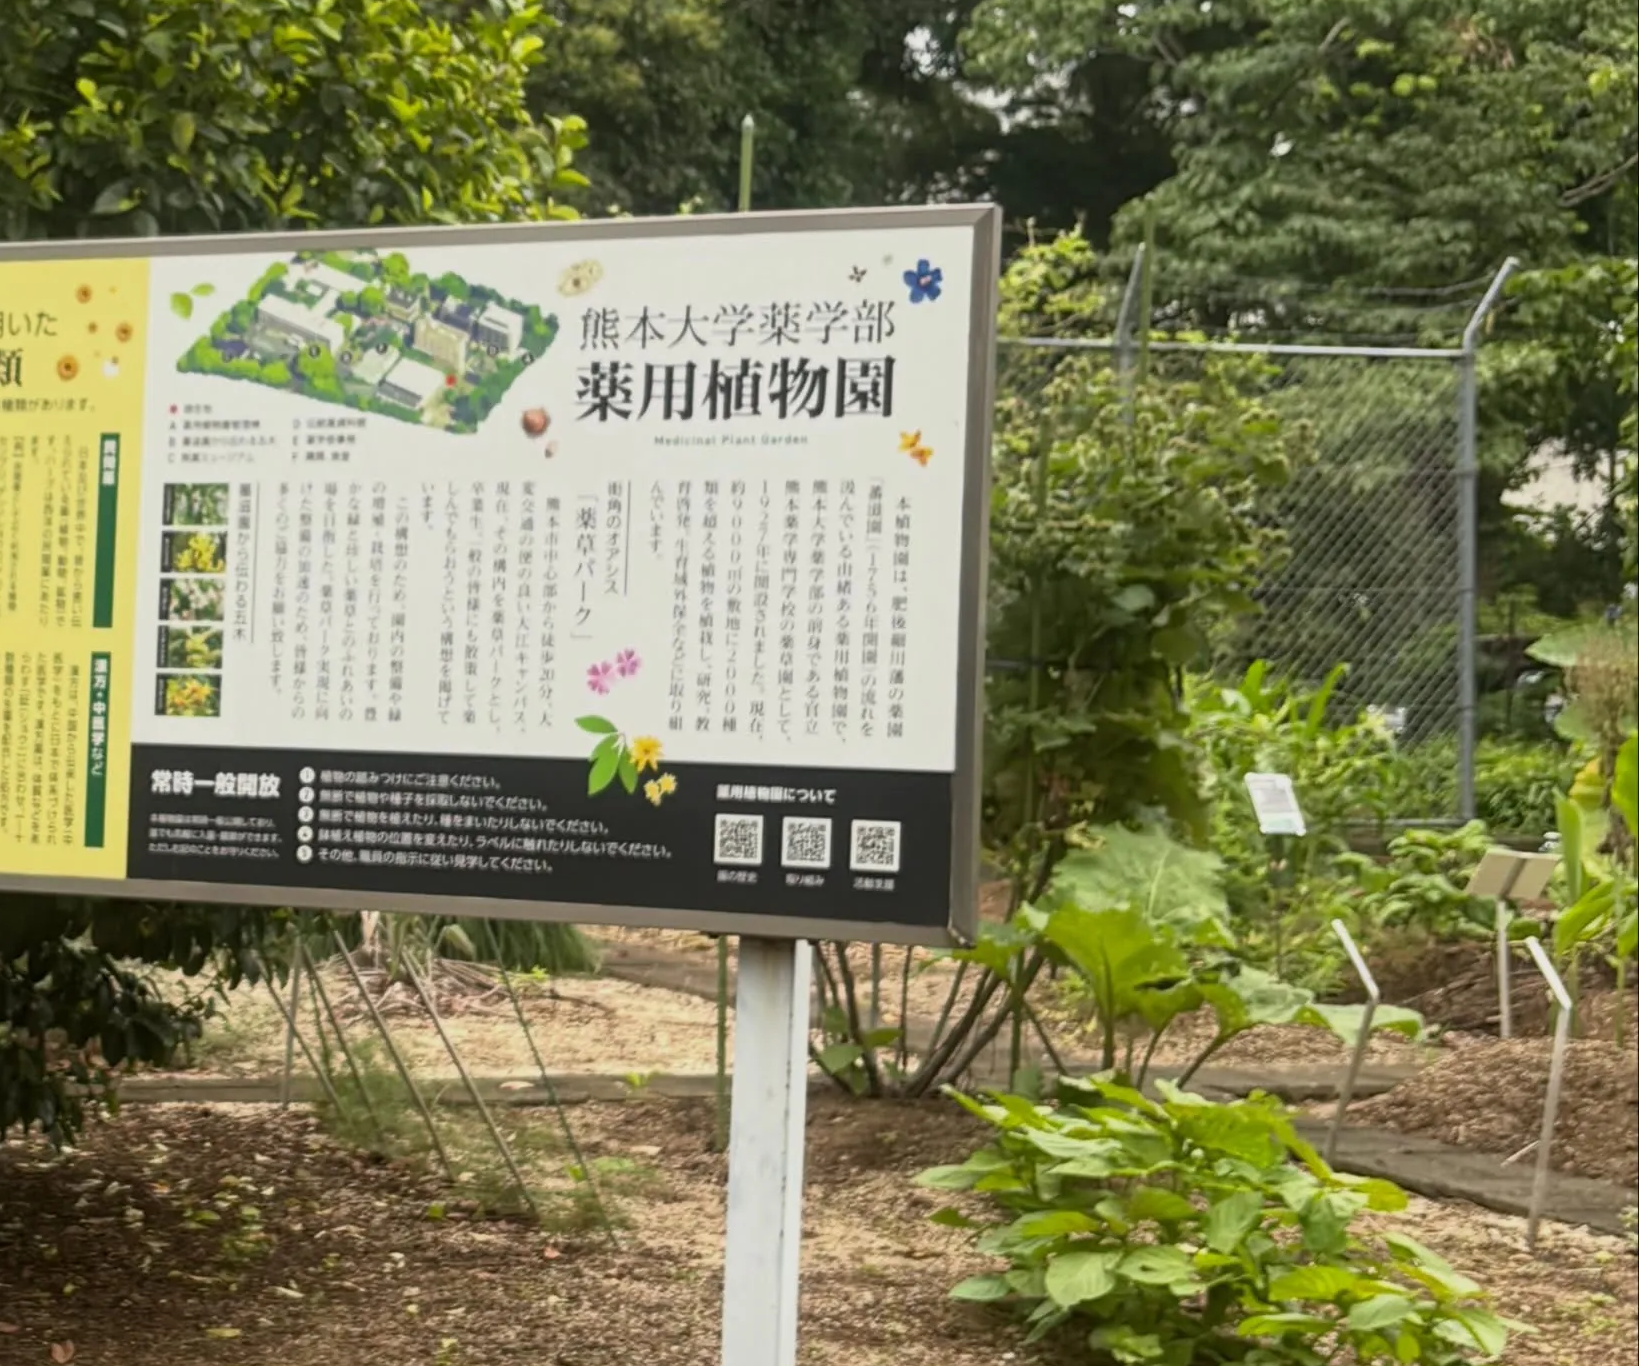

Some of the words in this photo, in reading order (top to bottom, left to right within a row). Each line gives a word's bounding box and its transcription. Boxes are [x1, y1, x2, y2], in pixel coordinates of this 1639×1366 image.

[580, 300, 896, 350] 熊本大学薬学部
[575, 355, 896, 422] 薬用植物園
[654, 434, 714, 447] Medicinal
[722, 434, 755, 446] Plant
[761, 434, 808, 446] Garden
[422, 484, 435, 531] います。
[604, 482, 623, 594] 街角のオアシス
[570, 494, 599, 639] 「薬草パーク」
[805, 480, 828, 735] 熊本大学薬学部の前身である官立
[151, 769, 282, 798] 常時一般開放
[716, 783, 837, 805] 薬用植物園について
